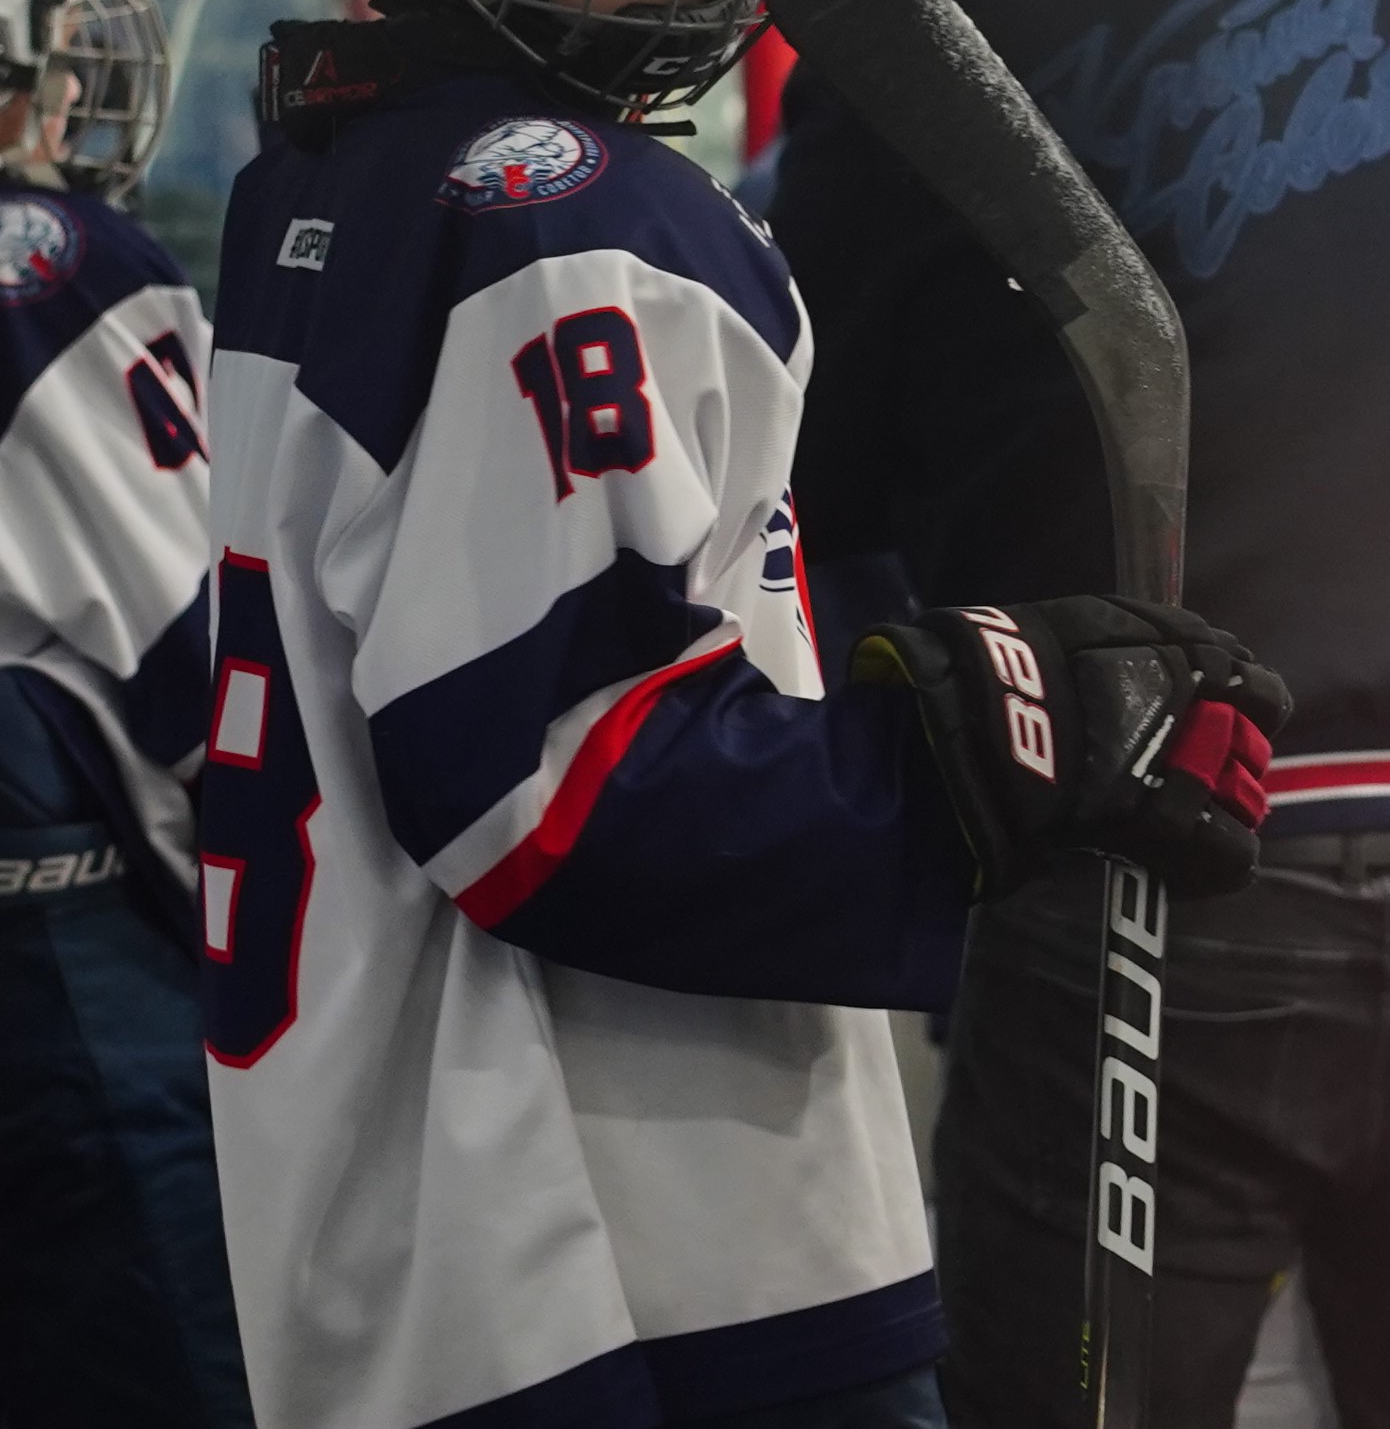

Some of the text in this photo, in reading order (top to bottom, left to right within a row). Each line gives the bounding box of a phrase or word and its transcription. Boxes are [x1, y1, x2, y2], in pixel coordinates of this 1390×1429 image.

[510, 305, 657, 506] 18
[957, 605, 1057, 784] BAU
[0, 844, 118, 895] BAU
[1097, 862, 1168, 1276] BAUE
